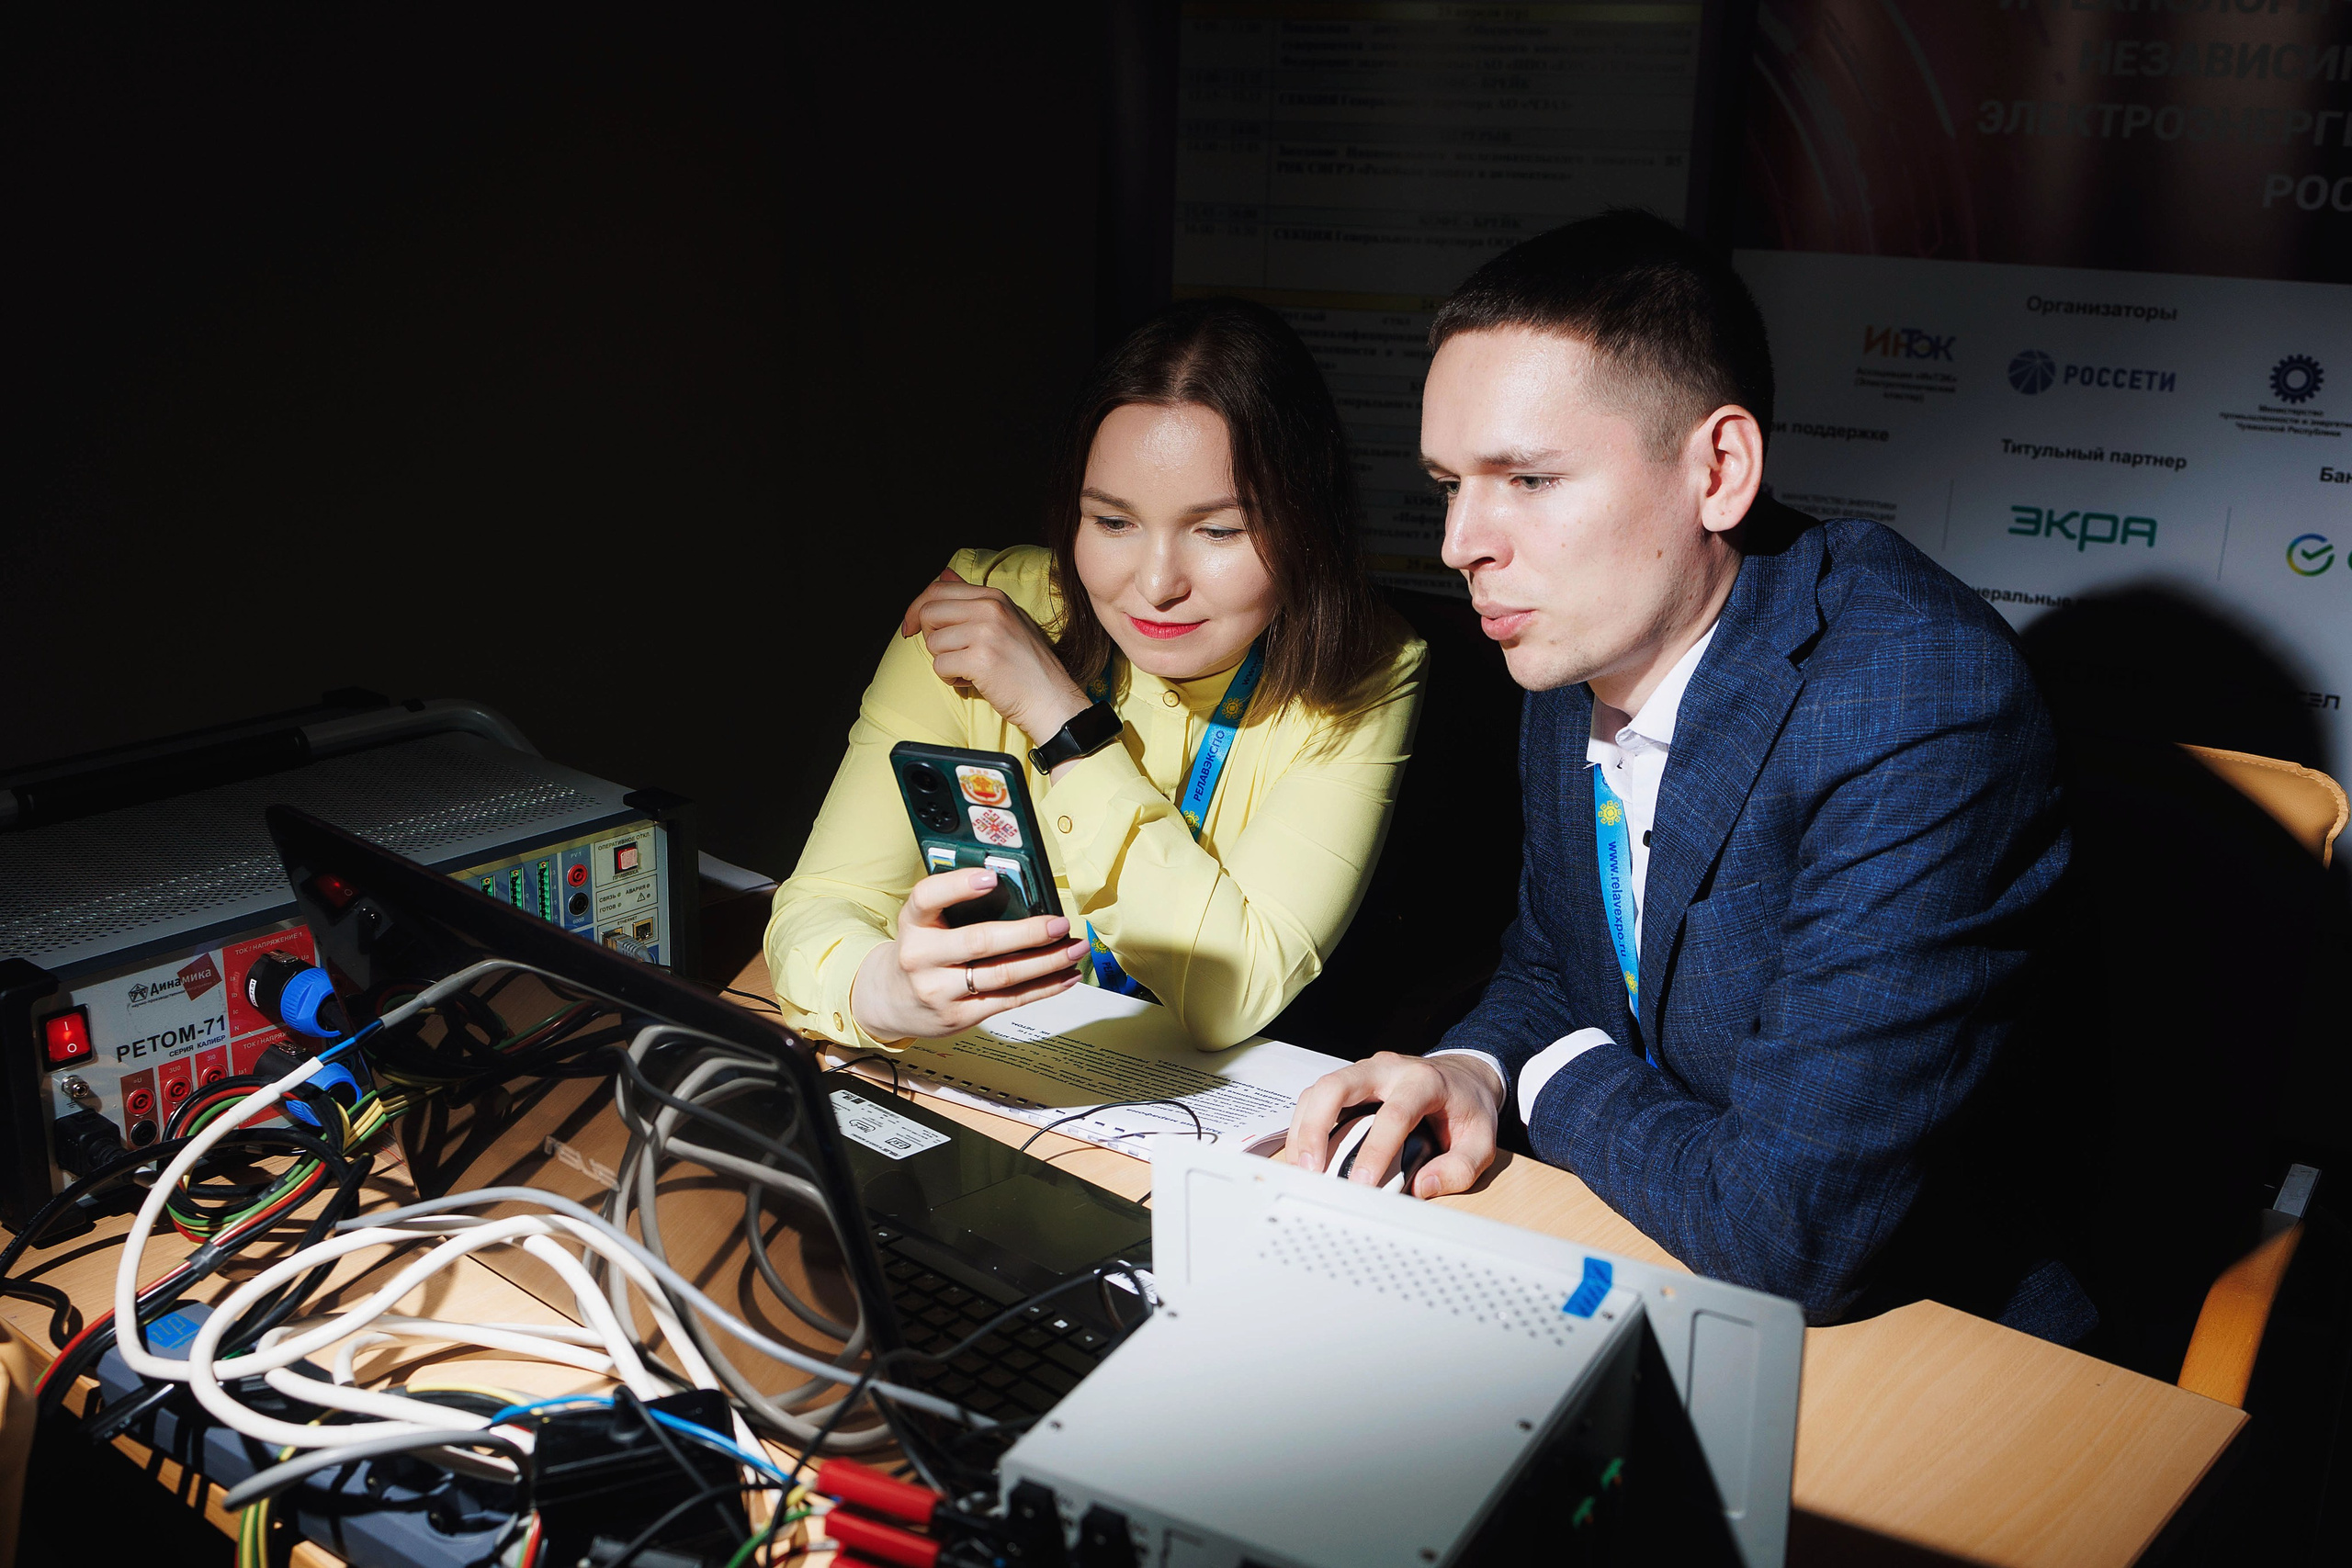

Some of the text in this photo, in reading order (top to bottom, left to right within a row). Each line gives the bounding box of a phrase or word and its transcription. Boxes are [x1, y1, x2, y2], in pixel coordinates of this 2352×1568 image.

[2078, 39, 2352, 81] НЕЗАВИСИ
[1976, 99, 2352, 147] ЭЛЕКТРОЭНЕРГ
[2026, 295, 2178, 321] Организаторы
[2064, 364, 2177, 392] РОССЕТИ
[1792, 421, 1890, 442] поддержке
[2001, 438, 2188, 471] Титульный партнер
[1193, 729, 1226, 802] РЕЛАВЭКСПО
[597, 836, 636, 851] ОПЕРАТИВНОЕ
[599, 884, 646, 903] СВЯЗЬ АВАРИЯ
[1608, 841, 1627, 957] www.relavexpo.ru
[599, 904, 616, 913] ГОТОВ
[235, 947, 249, 955] ТОК
[252, 932, 299, 950] НАПРЯЖЕНИЕ
[150, 967, 212, 997] Динамика
[117, 1014, 226, 1063] РЕТОМ-71
[169, 1034, 226, 1057] СЕРИЯ КАЛИБР
[243, 1041, 256, 1050] ТОК
